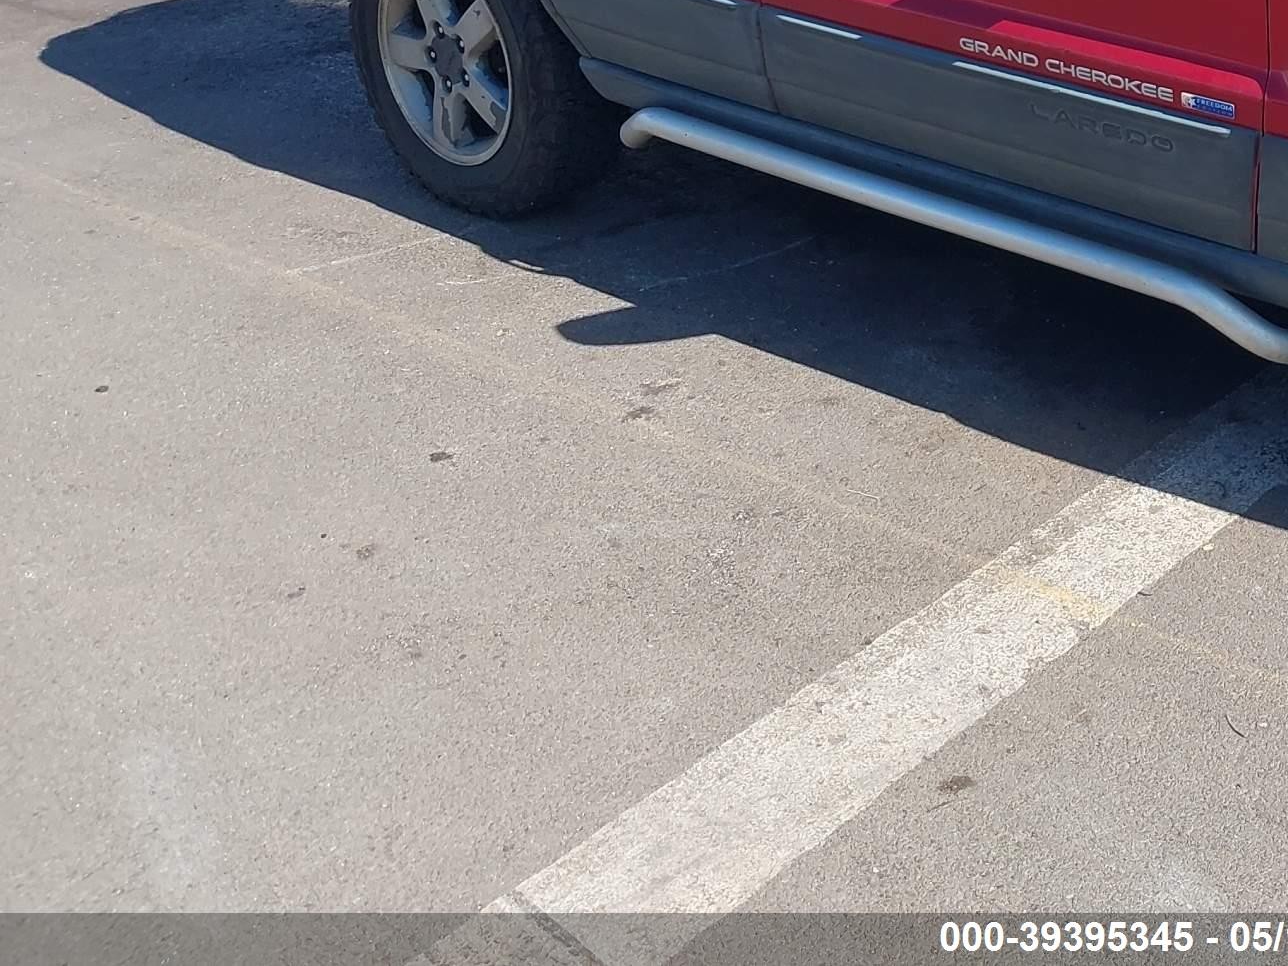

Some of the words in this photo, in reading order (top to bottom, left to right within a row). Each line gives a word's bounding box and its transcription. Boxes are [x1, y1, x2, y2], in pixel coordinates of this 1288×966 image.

[958, 37, 1039, 68] GRAND
[1045, 59, 1174, 103] CHEROKEE
[1030, 103, 1174, 153] LAREDO
